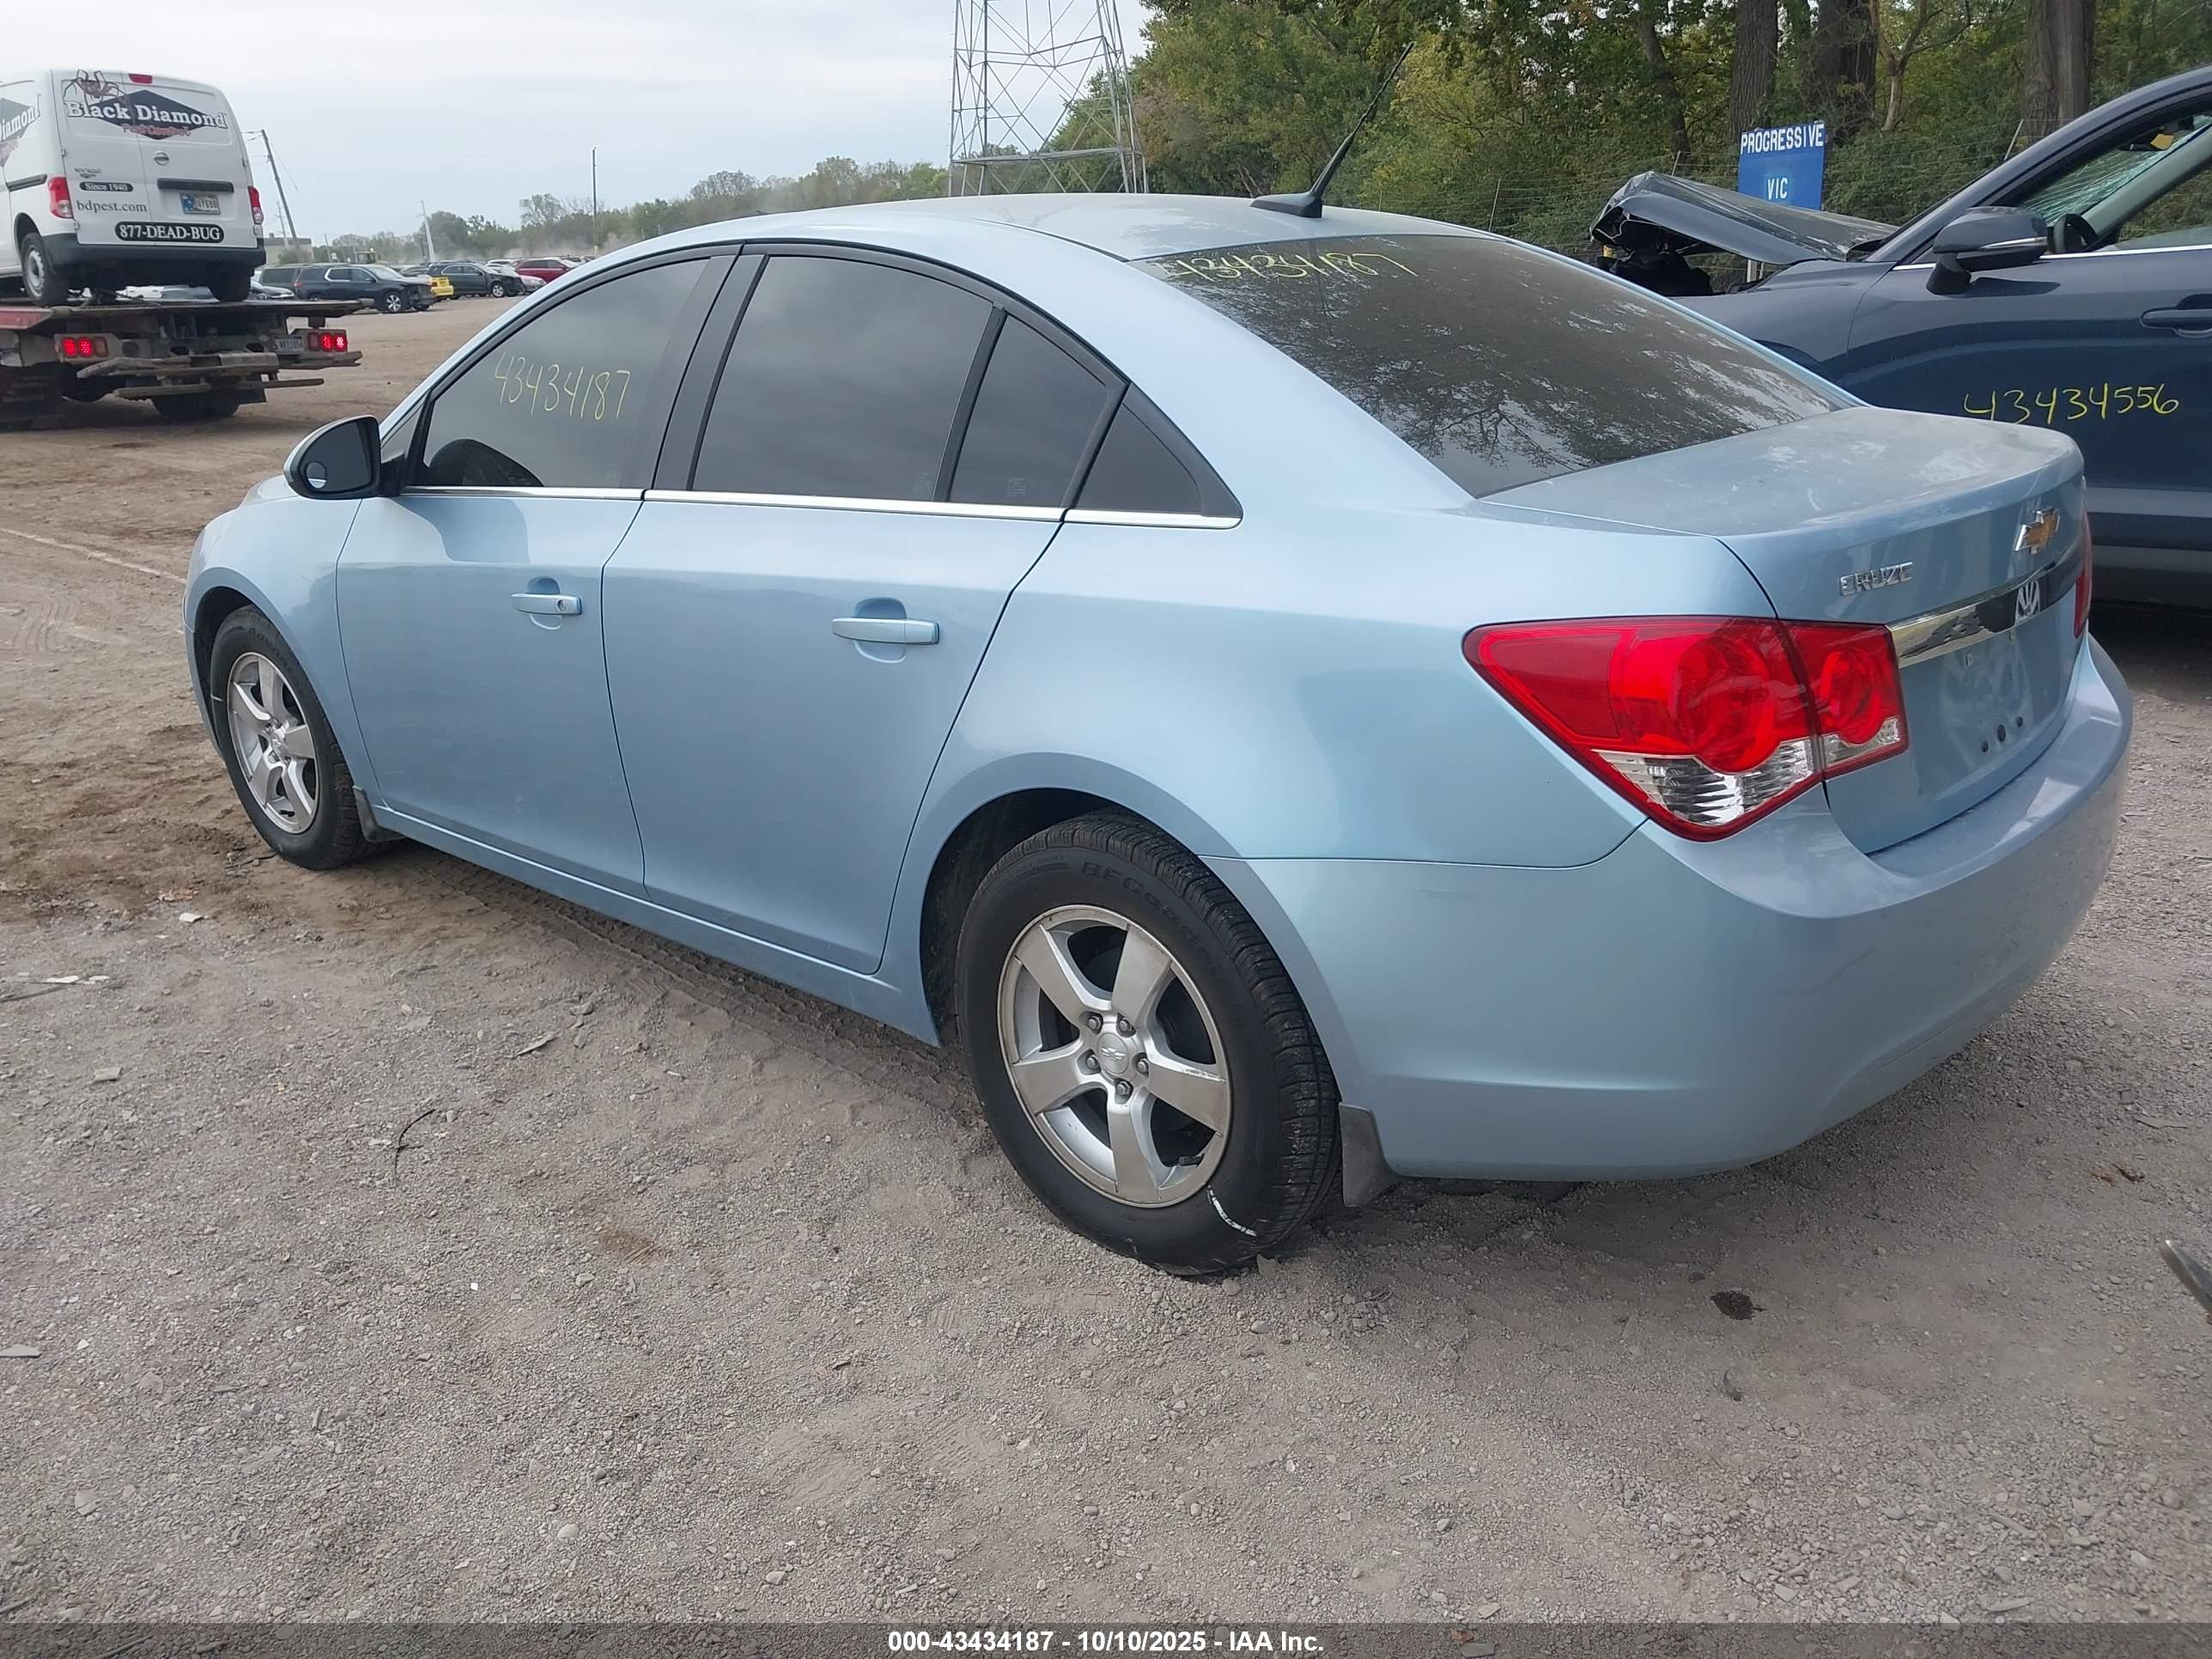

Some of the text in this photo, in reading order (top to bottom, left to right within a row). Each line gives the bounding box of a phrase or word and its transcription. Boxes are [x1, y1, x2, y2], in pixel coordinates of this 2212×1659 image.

[64, 100, 228, 129] Black Diamond
[1740, 123, 1825, 155] PROGRESSIVE
[85, 182, 128, 191] Since 1940
[1767, 177, 1788, 200] VIC
[76, 199, 148, 214] bdpest.com
[119, 224, 221, 240] 877-DEAD-BUG
[495, 351, 631, 420] 43434187
[1963, 382, 2180, 425] 43434556
[1839, 561, 1914, 597] CRUZE
